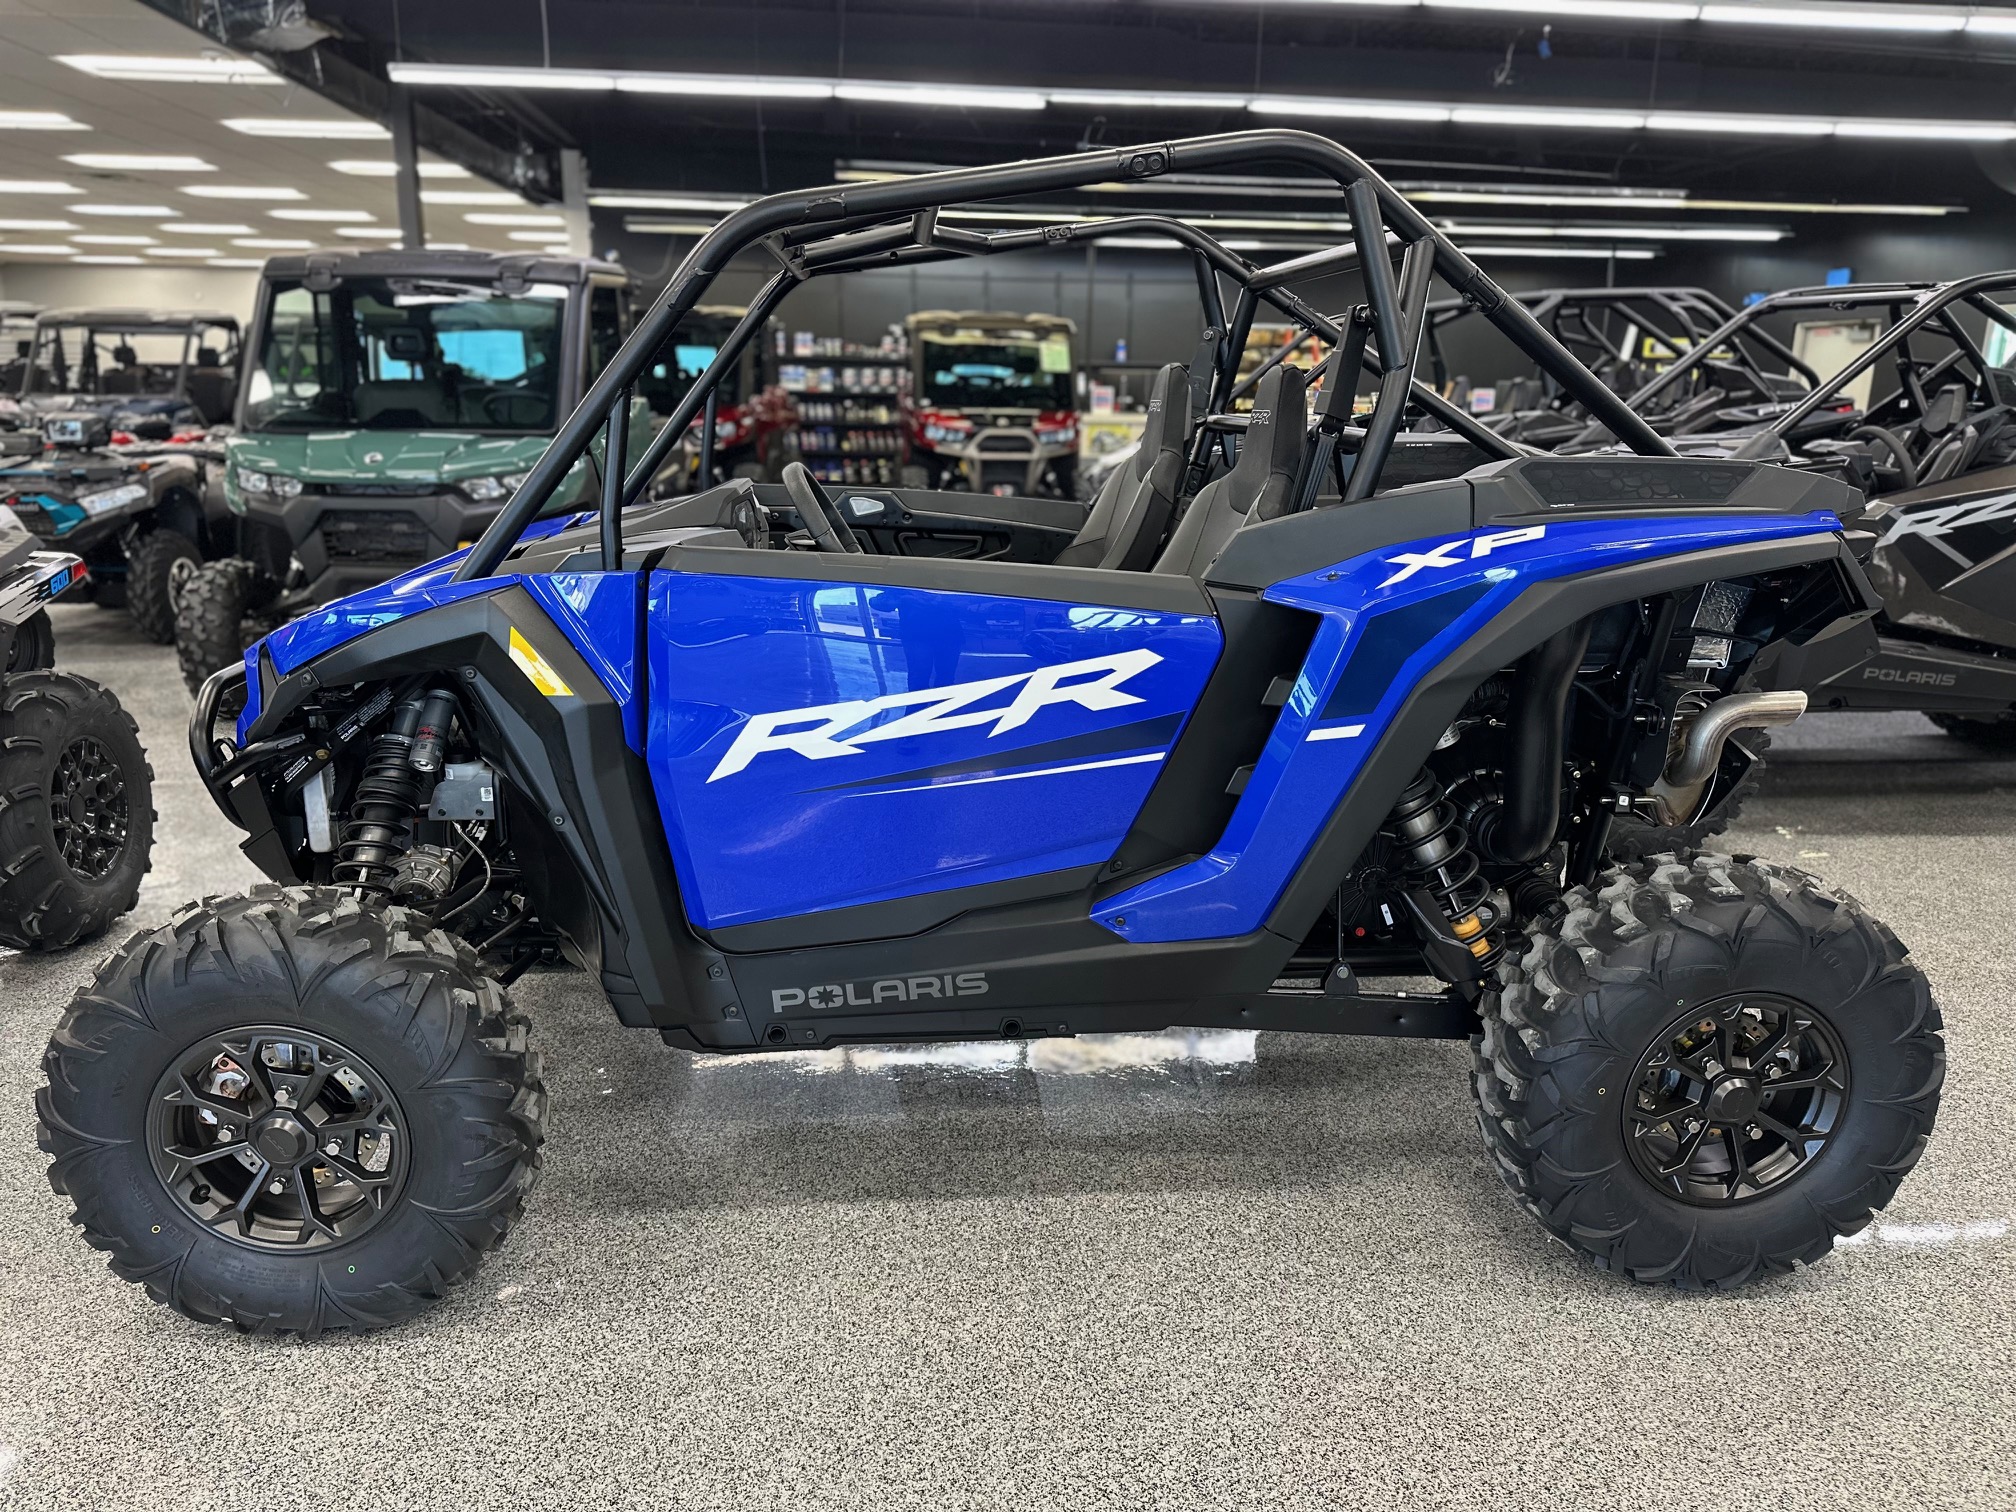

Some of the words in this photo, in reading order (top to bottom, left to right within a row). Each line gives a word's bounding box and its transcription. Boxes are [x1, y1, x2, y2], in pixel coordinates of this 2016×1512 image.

[1874, 493, 2016, 548] RZ
[50, 568, 69, 595] 600
[1375, 525, 1546, 590] XP
[1863, 667, 1957, 686] POLARIS
[705, 648, 1165, 783] RZR
[771, 972, 990, 1013] POLARIS
